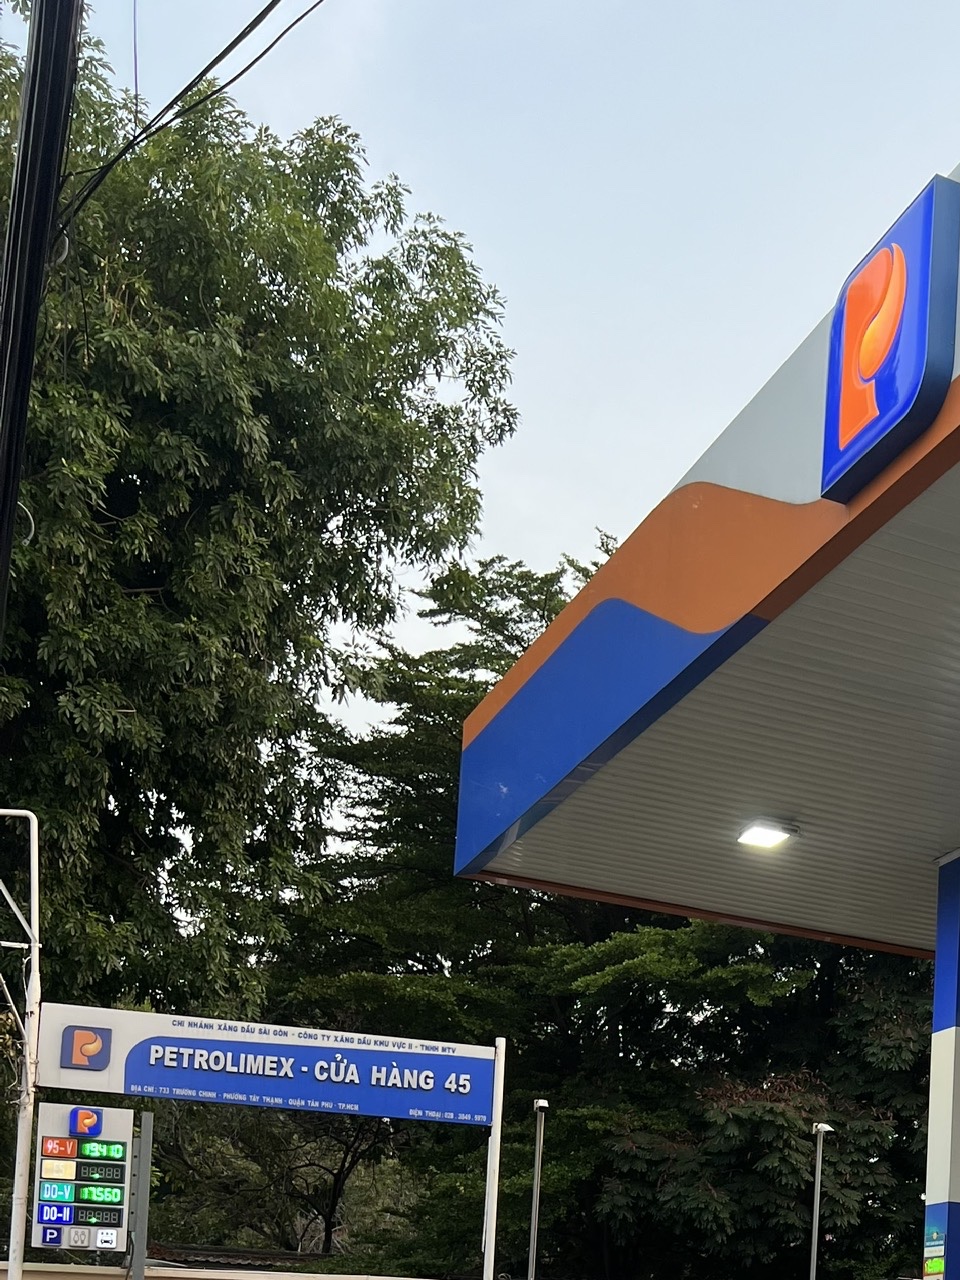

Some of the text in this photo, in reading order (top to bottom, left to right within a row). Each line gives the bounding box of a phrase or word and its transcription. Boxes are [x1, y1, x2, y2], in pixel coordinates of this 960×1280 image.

[187, 1020, 214, 1030] NHÁNH
[298, 1031, 318, 1040] CÔNG
[374, 1039, 389, 1048] KHU
[420, 1044, 439, 1052] TNHH
[441, 1046, 457, 1054] MTV
[150, 1045, 295, 1078] PETROLIMEX
[314, 1054, 360, 1084] CỬA
[371, 1062, 435, 1090] HÀNG
[444, 1073, 471, 1094] 45
[159, 1086, 170, 1094] 733
[47, 1139, 73, 1155] 95-V
[44, 1183, 71, 1199] DO-V
[43, 1205, 70, 1221] DO-II
[46, 1229, 58, 1242] P
